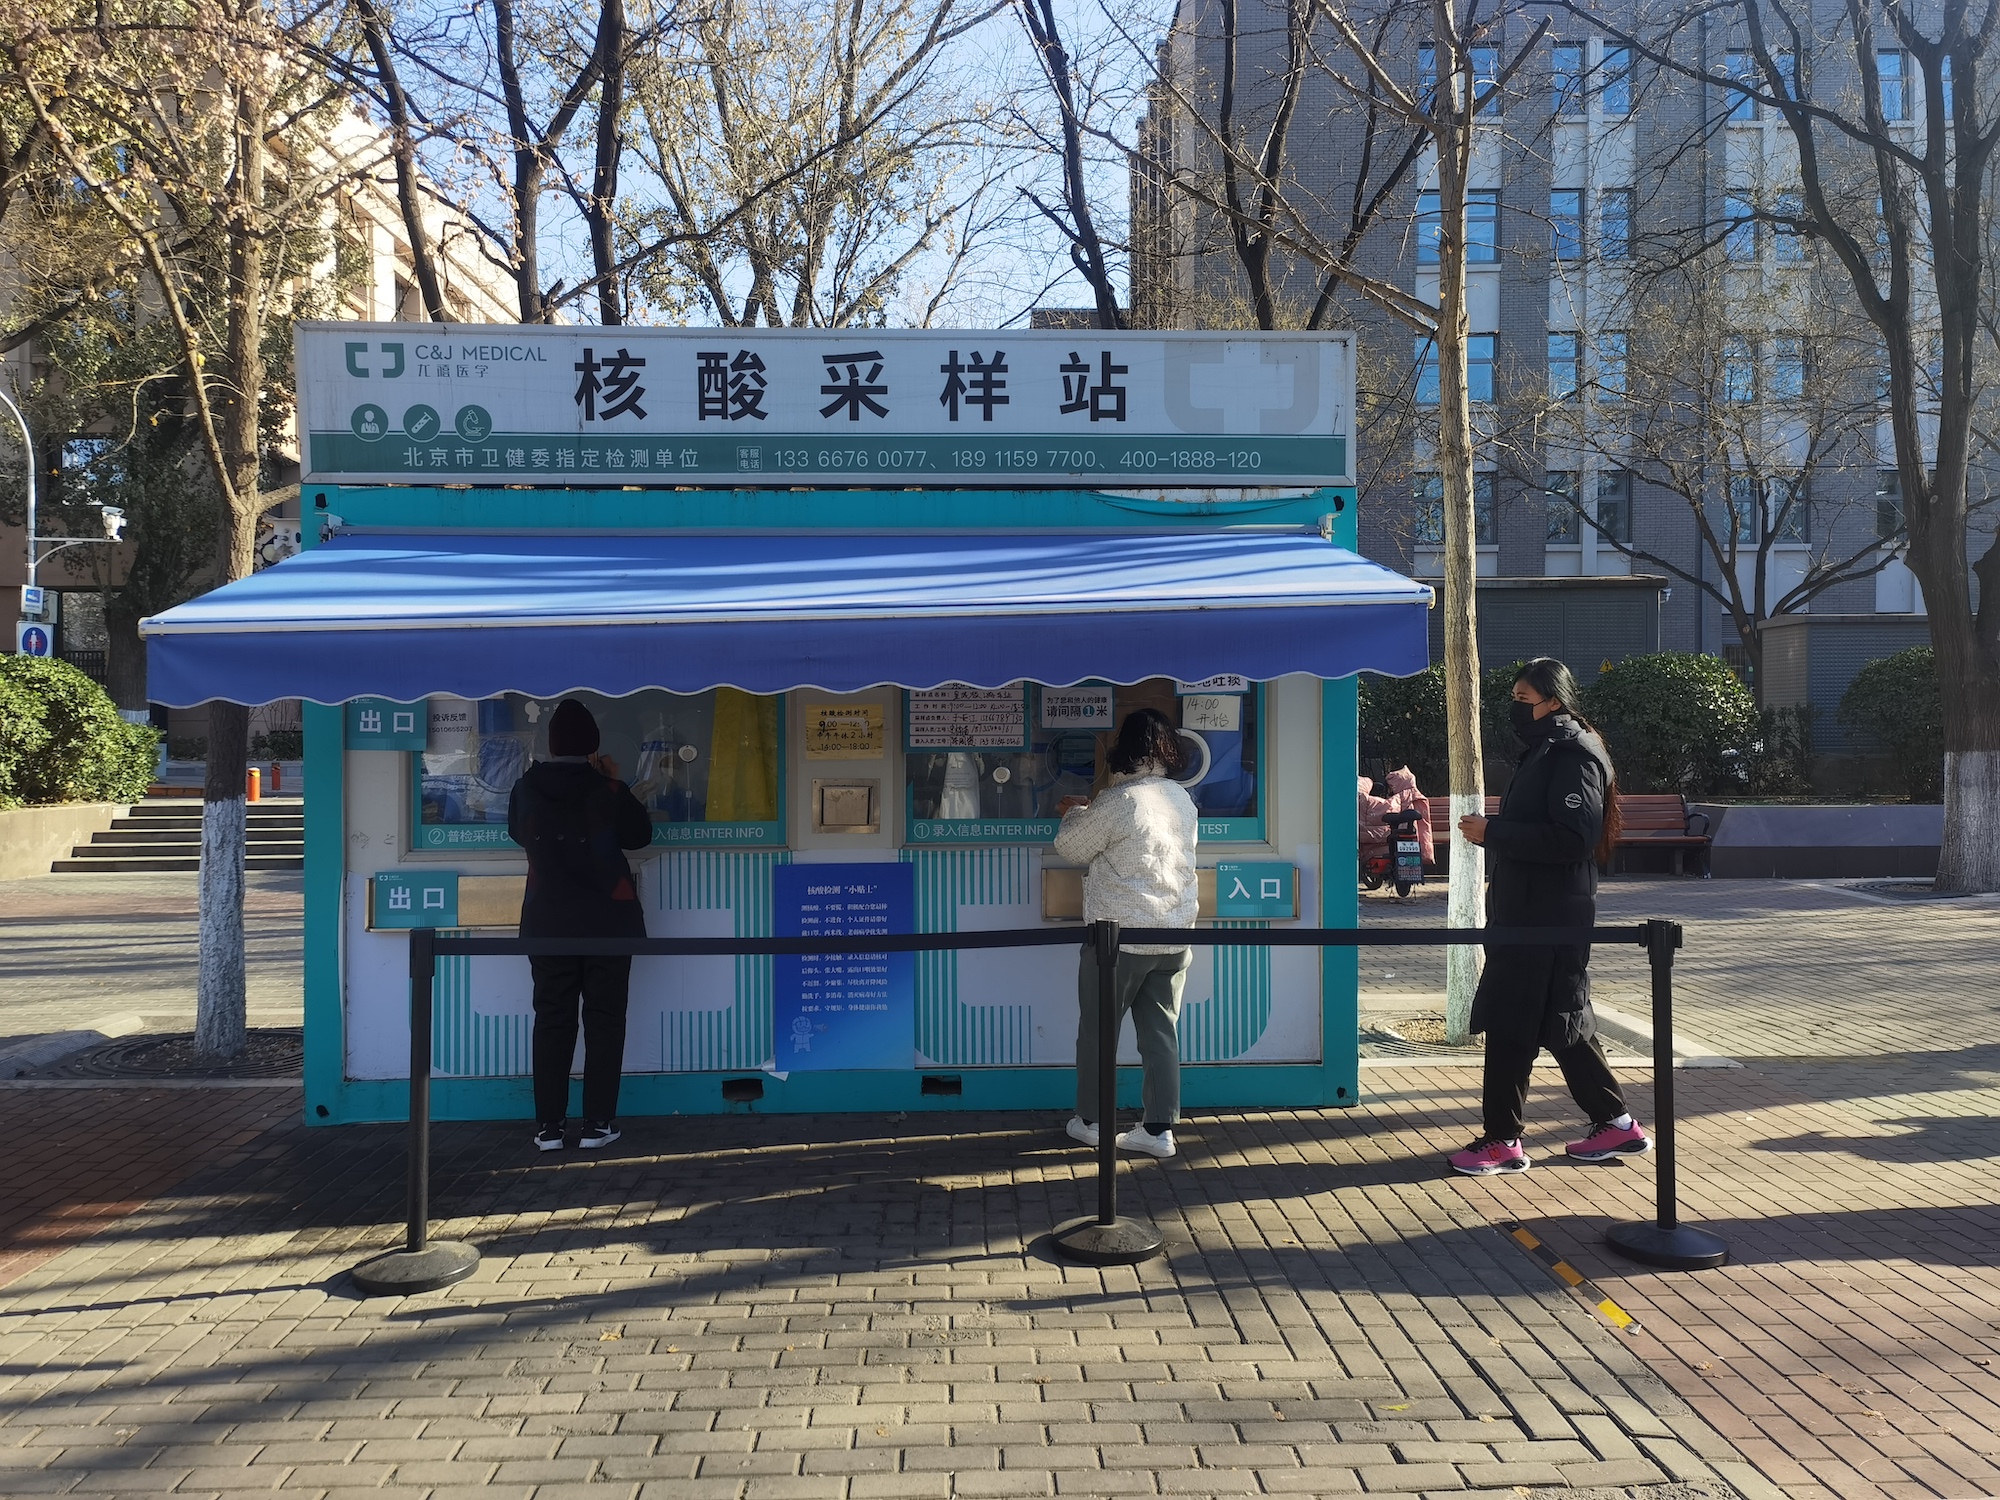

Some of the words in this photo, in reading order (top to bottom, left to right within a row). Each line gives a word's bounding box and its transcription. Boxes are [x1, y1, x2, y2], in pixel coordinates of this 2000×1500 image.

[415, 345, 452, 360] C&J
[462, 346, 547, 361] MEDICAL
[574, 347, 1129, 422] 核酸采样站
[403, 447, 699, 468] 北京市卫健委指定检测单位
[739, 448, 760, 458] 客服
[774, 450, 809, 467] 133
[818, 450, 868, 467] 6676
[995, 450, 1038, 467] 1159
[739, 458, 760, 469] 电话
[1182, 676, 1241, 689] 地吐痰
[1046, 696, 1107, 704] 为了您和他人的健康
[1186, 698, 1220, 710] 14:00
[432, 713, 467, 722] 投诉反馈
[820, 709, 869, 717] 核酸检测时间
[1196, 712, 1230, 728] 开始
[359, 709, 414, 733] 出口
[651, 827, 692, 841] 入信息
[693, 826, 732, 839] ENTER
[735, 826, 764, 839] INFO
[984, 824, 1022, 836] ENTER
[1025, 824, 1053, 836] INFO
[1199, 823, 1231, 835] TEST
[1228, 876, 1281, 900] 入口
[389, 886, 444, 910] 出口
